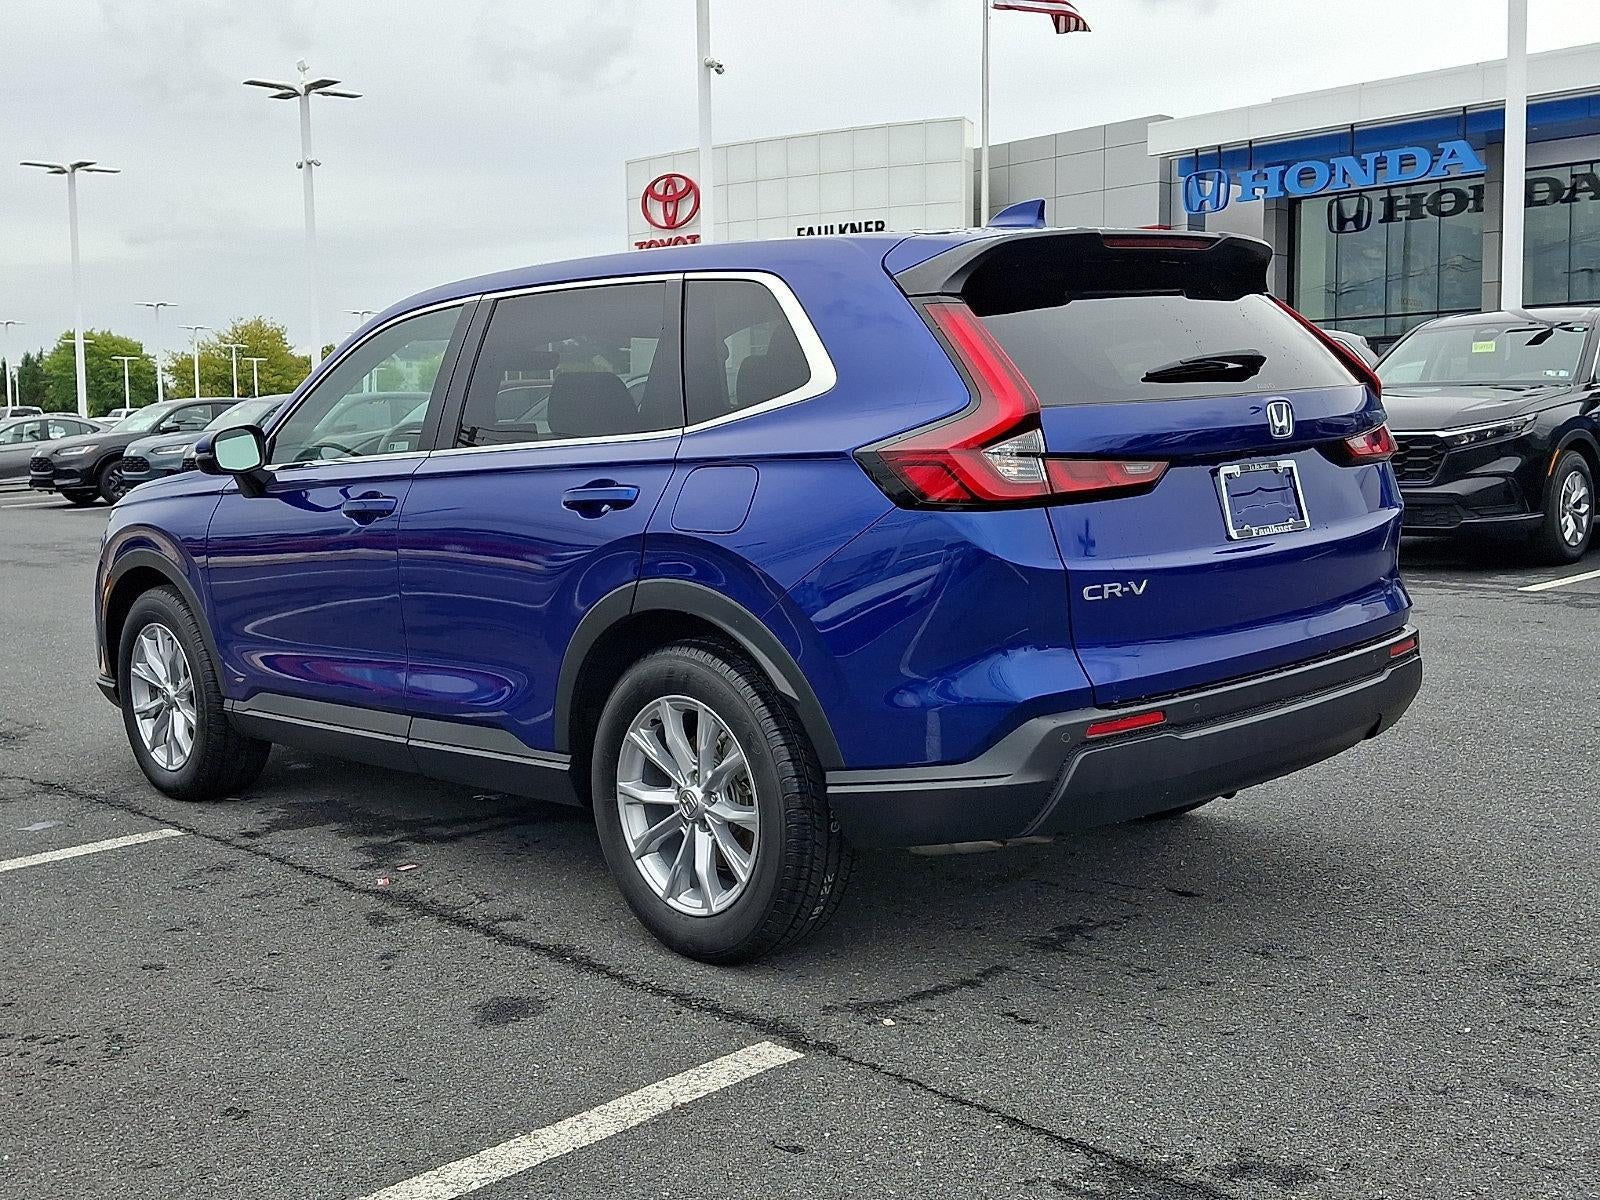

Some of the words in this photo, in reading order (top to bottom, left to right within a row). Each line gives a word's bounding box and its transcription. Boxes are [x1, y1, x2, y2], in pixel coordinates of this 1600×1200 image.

[1236, 139, 1487, 202] HONDA
[1252, 523, 1292, 536] Faulkner
[1083, 579, 1148, 601] CR-V
